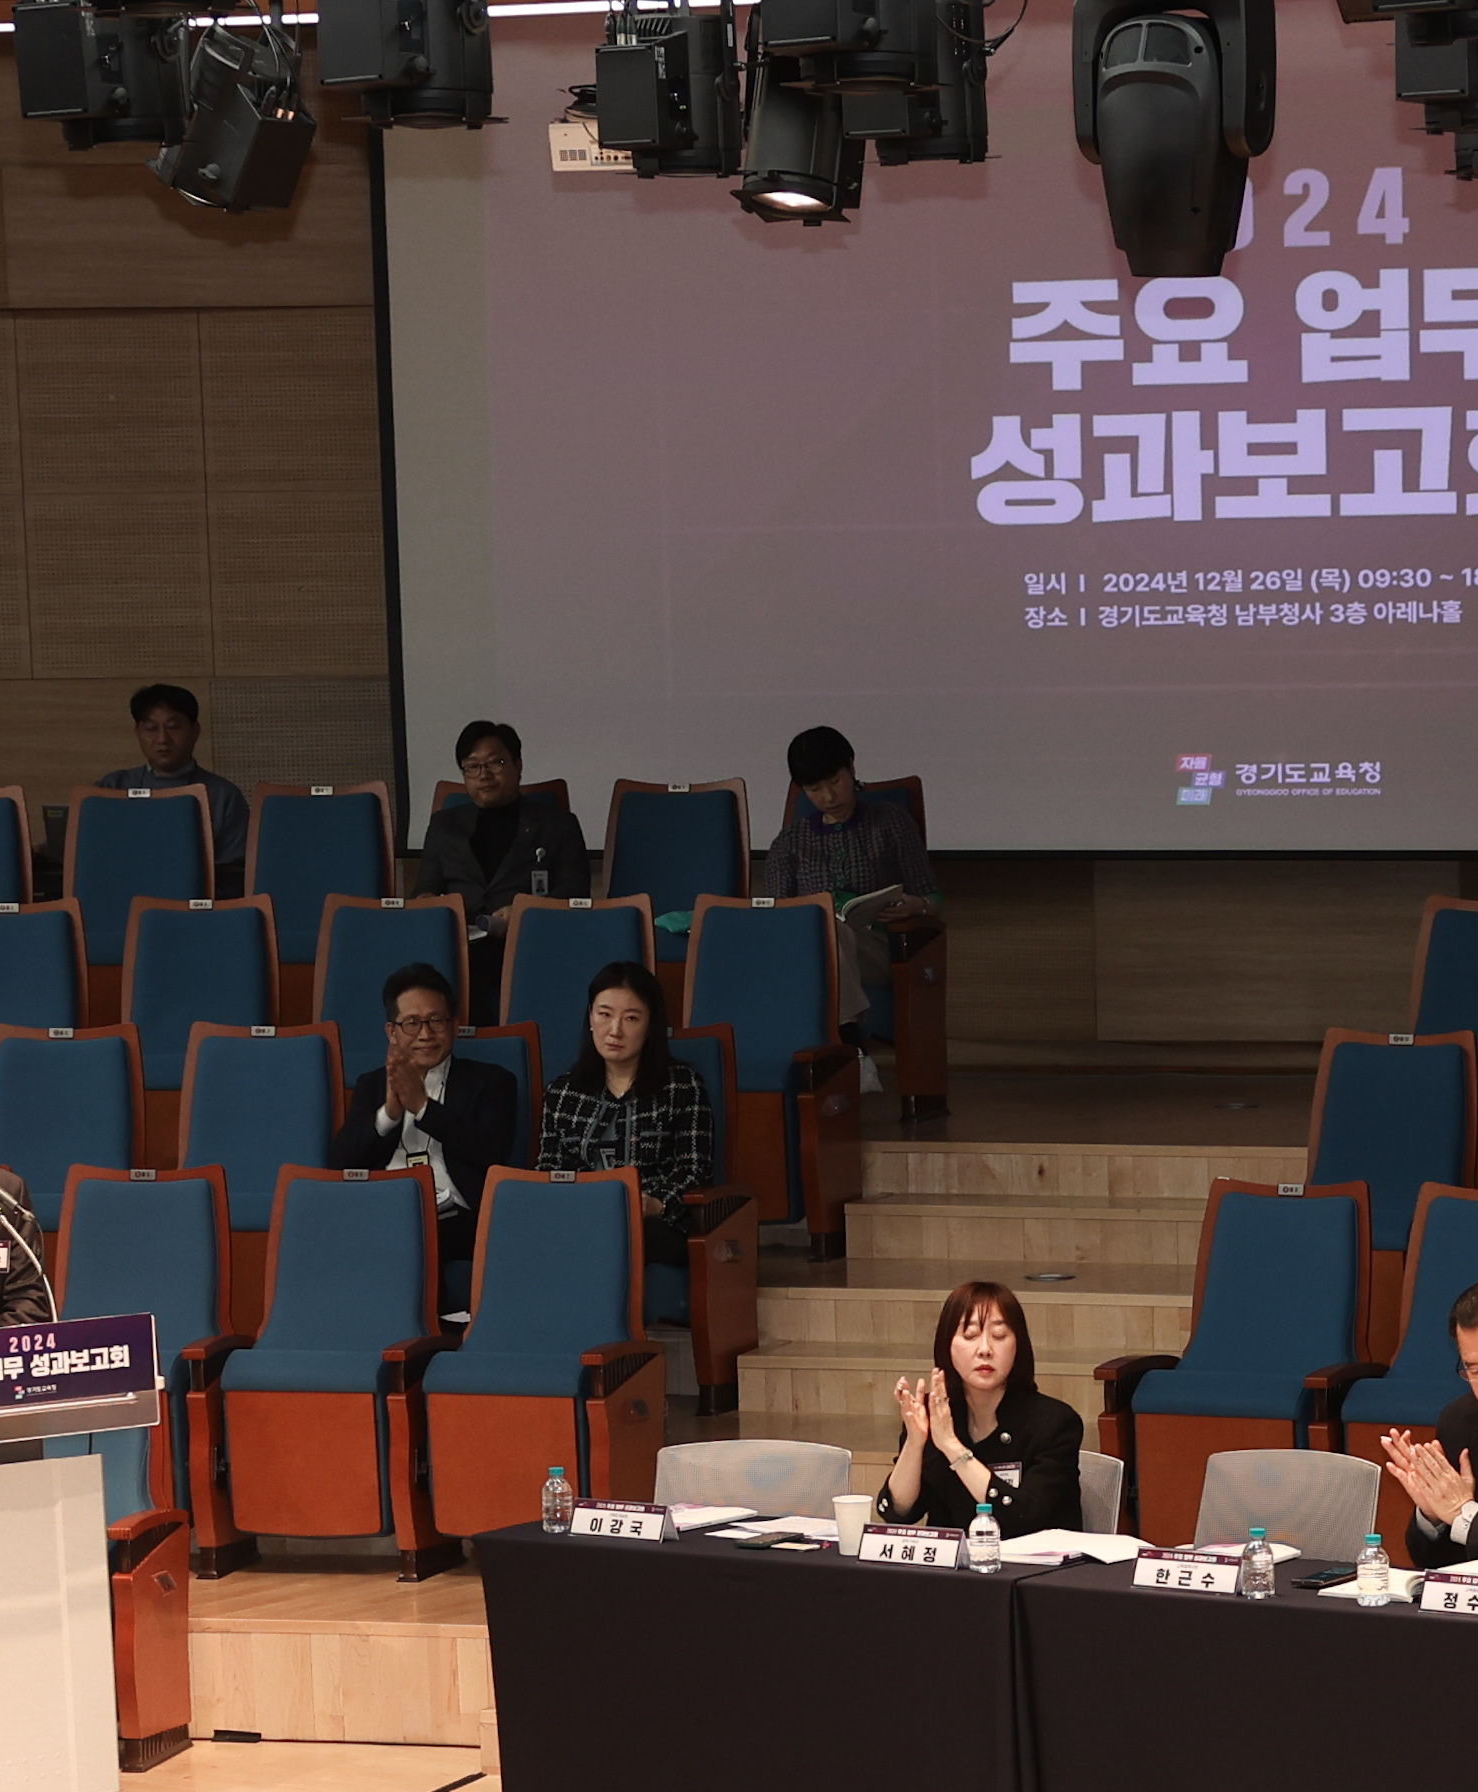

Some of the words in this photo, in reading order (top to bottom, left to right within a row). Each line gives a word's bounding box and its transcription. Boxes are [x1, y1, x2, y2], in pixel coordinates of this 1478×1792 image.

[1235, 167, 1410, 250] 24
[1009, 277, 1248, 390] 주요
[1024, 572, 1067, 595] 일시
[1103, 570, 1188, 593] 2024년
[1194, 570, 1244, 592] 12월
[1249, 569, 1303, 592] 26일
[1310, 568, 1351, 593] (목)
[1358, 568, 1432, 589] 09:30
[1024, 606, 1068, 629] 장소
[1098, 603, 1228, 629] 경기도교육청
[1234, 602, 1323, 627] 남부청사
[1329, 602, 1368, 625] 3층
[1373, 600, 1463, 625] 아레나홀
[1235, 761, 1381, 785] 경기도교육청
[9, 1333, 56, 1353] 2024
[30, 1344, 130, 1378] 성과보고회
[589, 1517, 643, 1536] 이강국
[879, 1544, 937, 1563] 서혜정
[1155, 1568, 1215, 1589] 한근수
